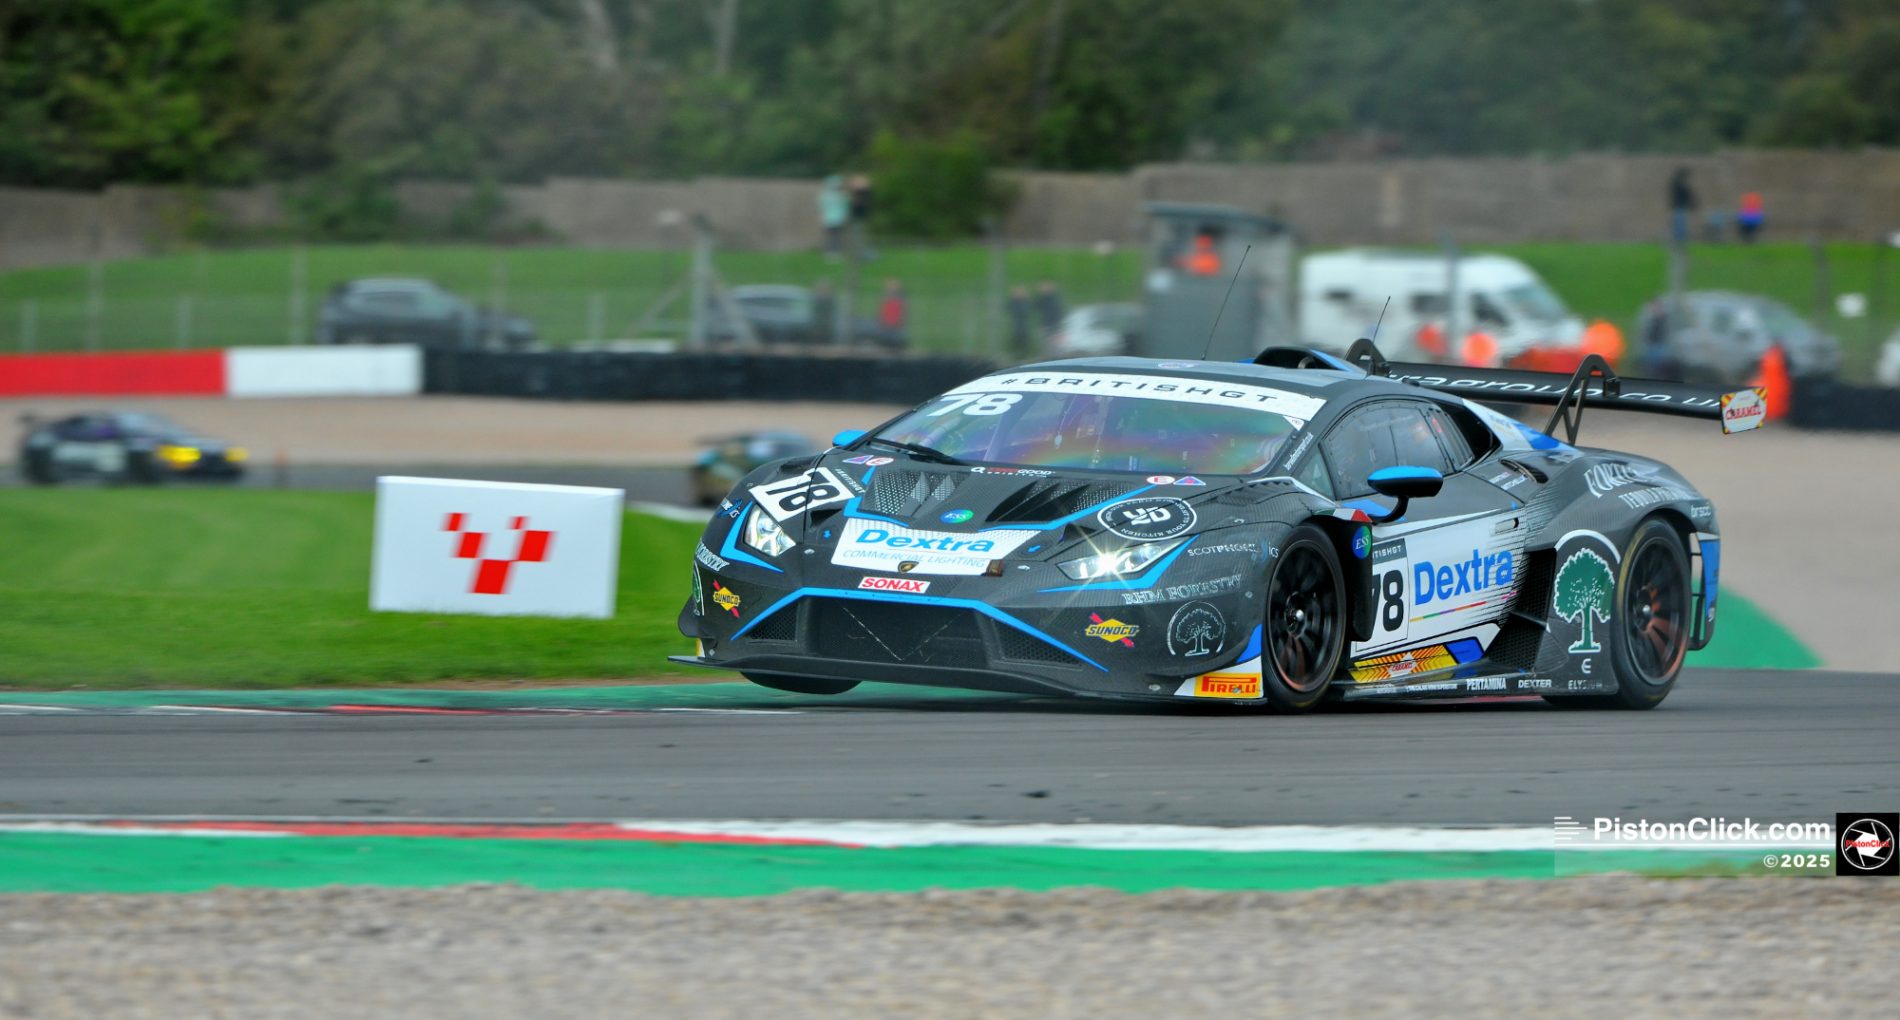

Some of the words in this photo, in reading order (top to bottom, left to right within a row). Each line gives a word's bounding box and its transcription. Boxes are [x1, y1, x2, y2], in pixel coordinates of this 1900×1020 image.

[1001, 378, 1278, 402] #BRITISHGT
[926, 393, 1024, 416] 78
[765, 471, 841, 512] 78
[855, 529, 995, 553] Dextra
[1355, 538, 1371, 550] ESS
[842, 549, 924, 563] COMMERCIAL
[927, 556, 986, 569] LIGHTING
[861, 577, 925, 593] SONAX
[1413, 549, 1513, 606] Dextra
[714, 593, 740, 605] SUNOCO
[1372, 569, 1405, 632] 78
[1087, 625, 1138, 636] SUNOCO
[1202, 676, 1257, 693] PIRELLI
[1466, 679, 1507, 691] PERTAMINA
[1518, 679, 1552, 689] DEXTER
